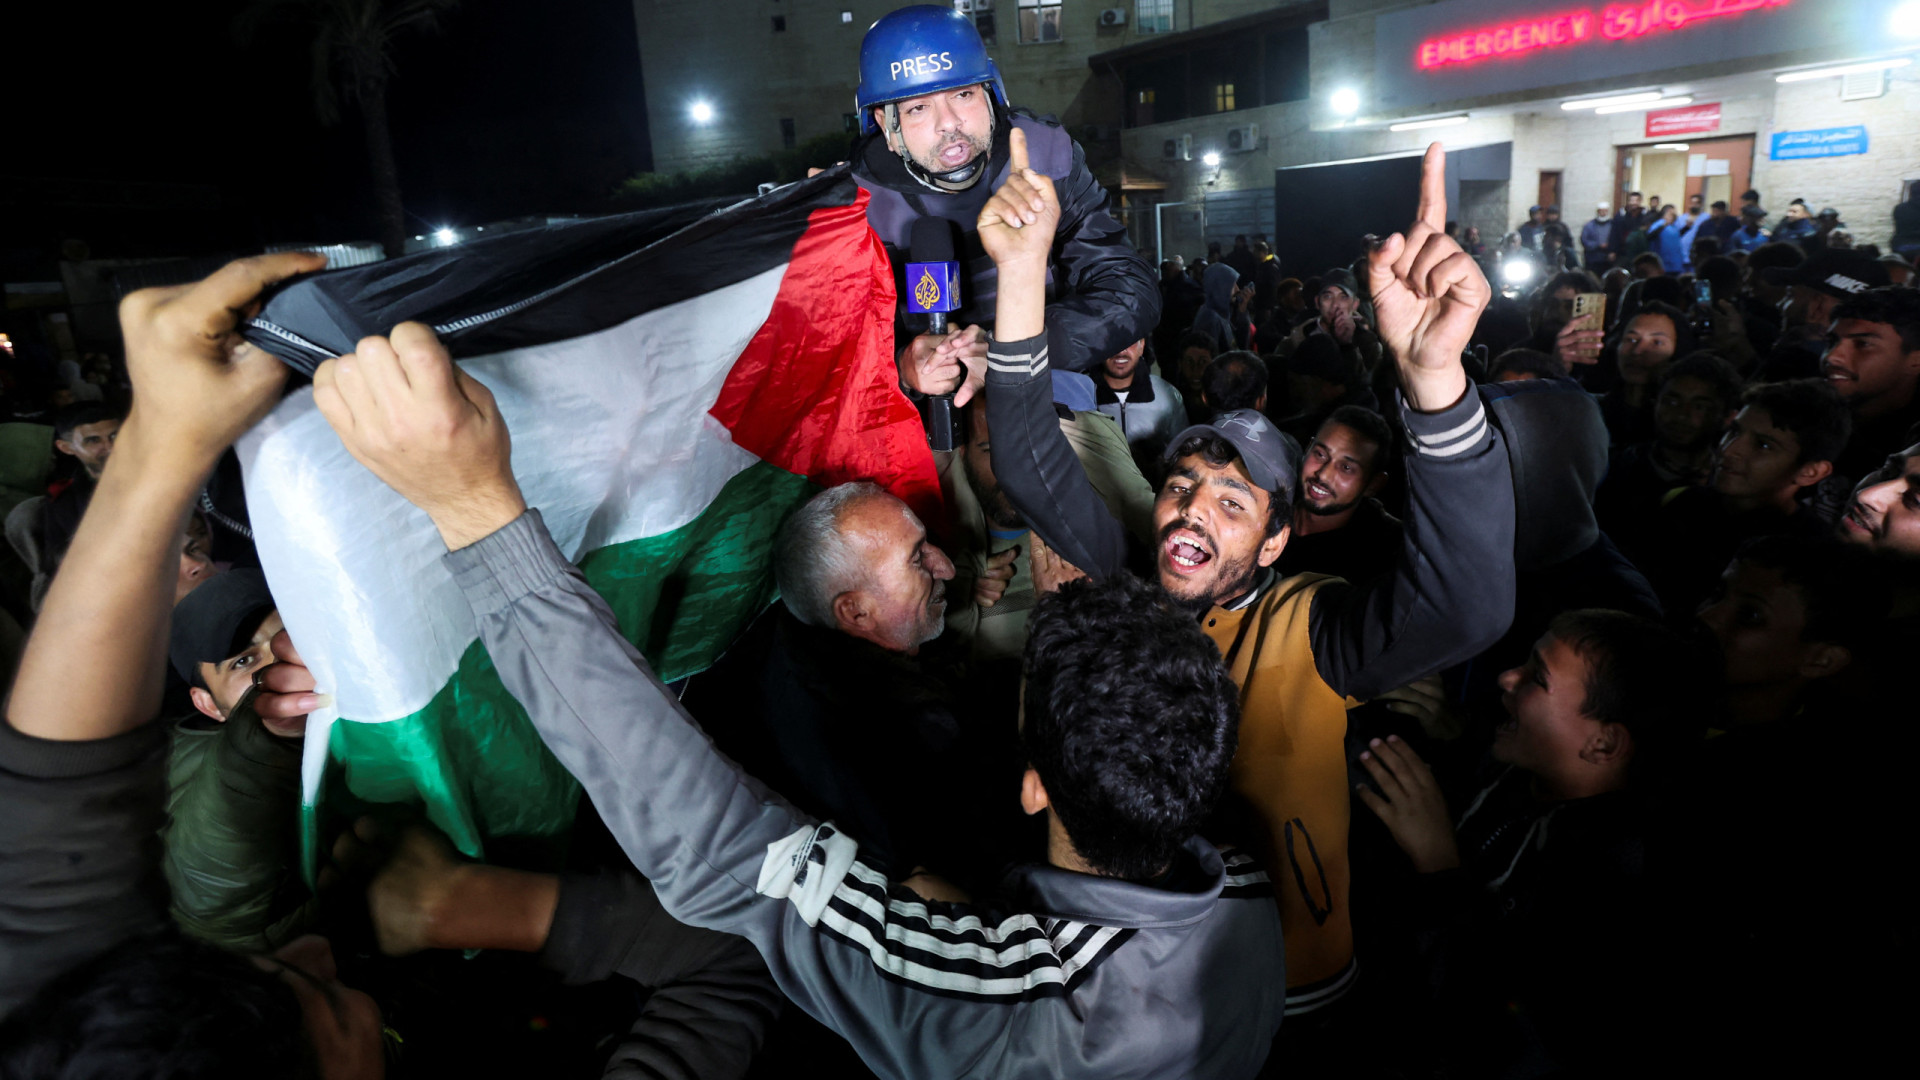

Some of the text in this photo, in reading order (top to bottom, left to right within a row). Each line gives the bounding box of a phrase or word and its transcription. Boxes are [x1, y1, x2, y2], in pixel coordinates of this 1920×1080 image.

[1418, 12, 1592, 68] EMERGENCY
[890, 51, 953, 81] PRESS
[1824, 273, 1870, 294] NIKE
